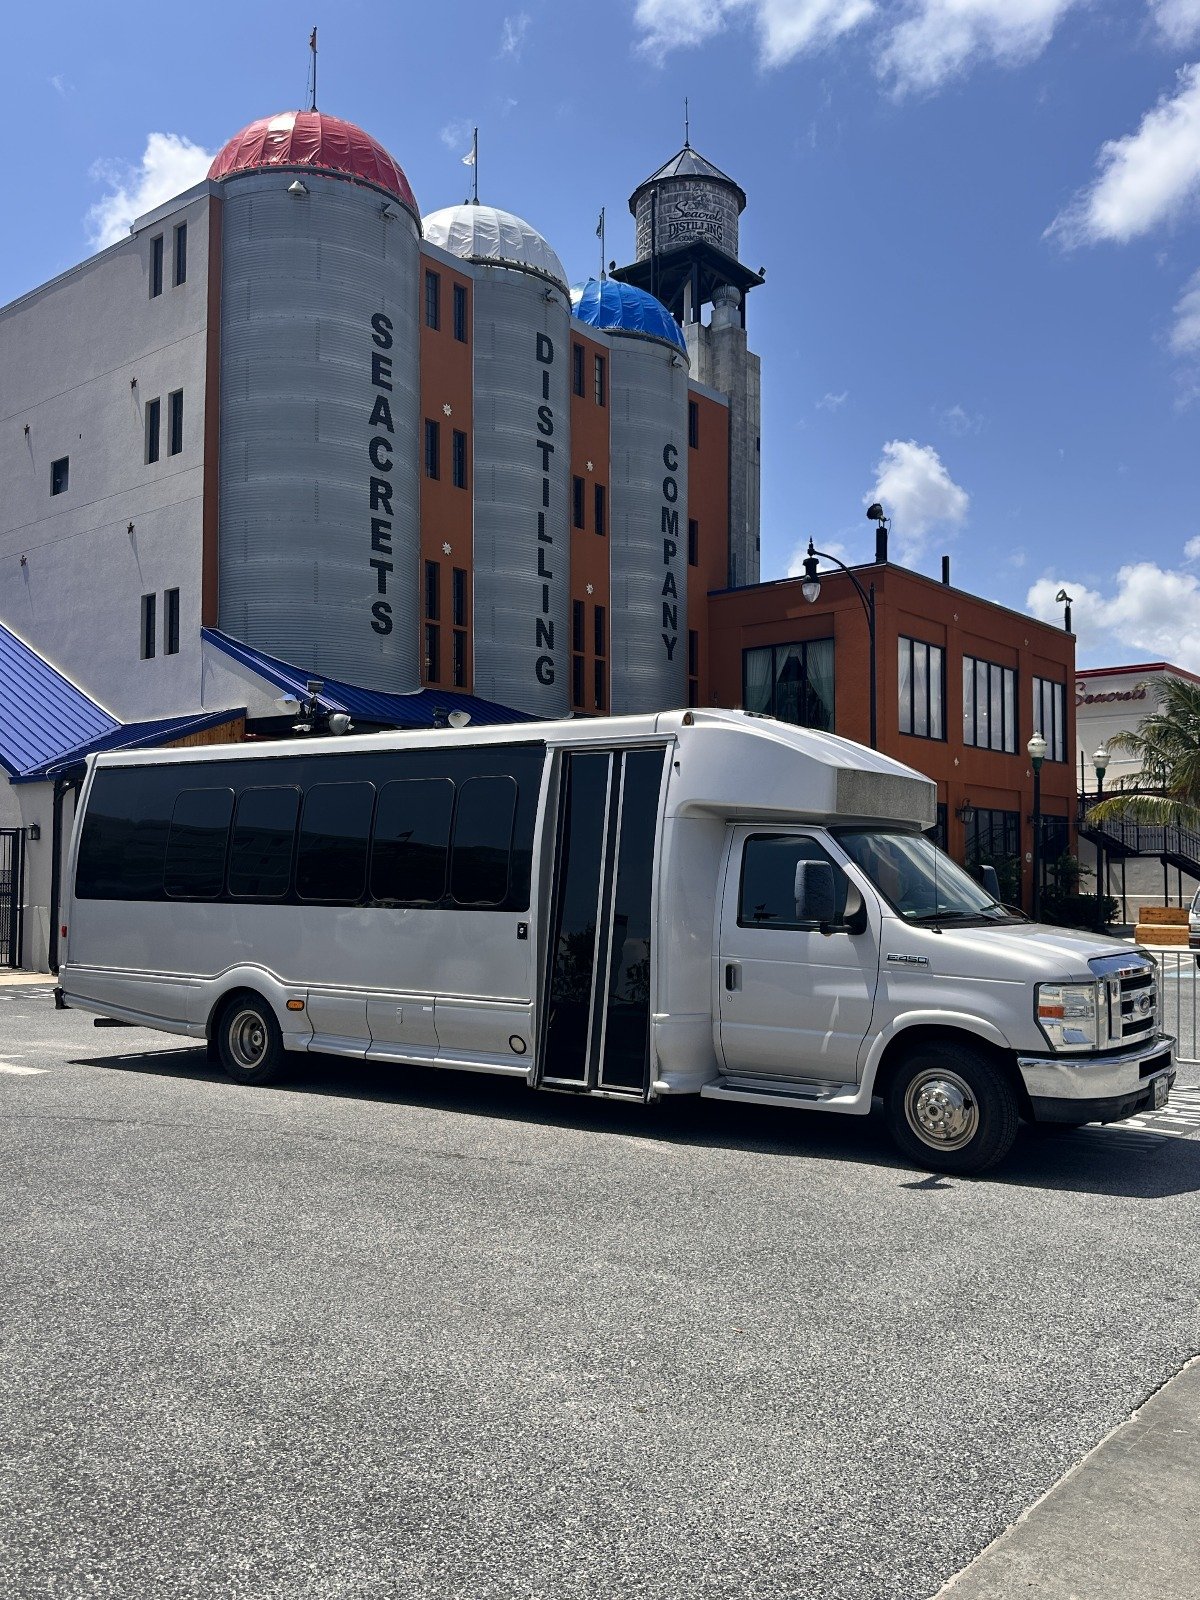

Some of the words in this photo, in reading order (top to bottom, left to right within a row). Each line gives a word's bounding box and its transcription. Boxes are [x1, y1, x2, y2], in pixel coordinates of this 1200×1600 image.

[669, 200, 722, 222] Seacrets
[669, 222, 722, 240] DISTILLING
[368, 312, 394, 635] SEACRETS
[535, 332, 555, 685] DISTILLING
[661, 443, 678, 661] COMPANY
